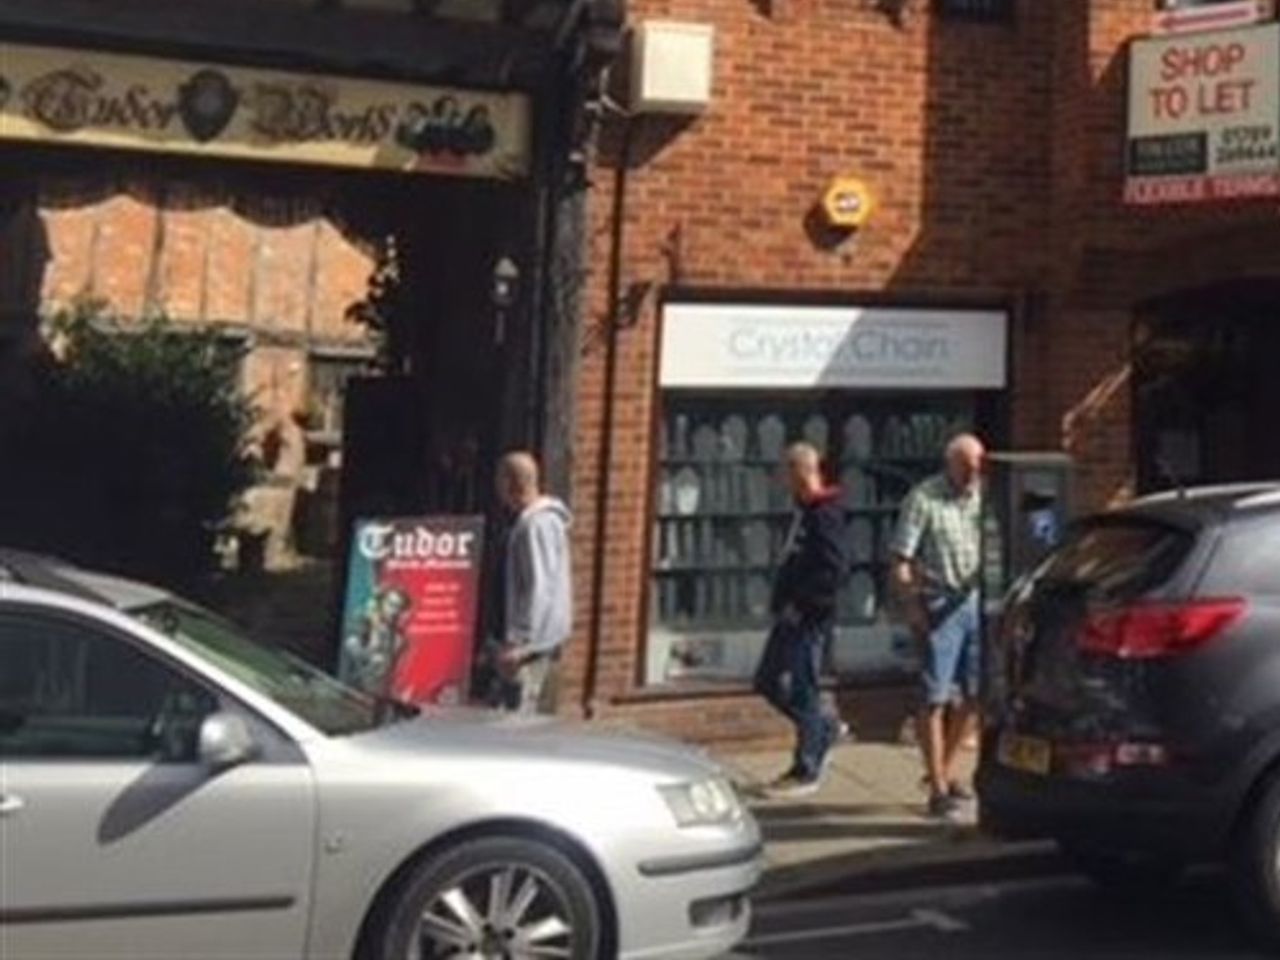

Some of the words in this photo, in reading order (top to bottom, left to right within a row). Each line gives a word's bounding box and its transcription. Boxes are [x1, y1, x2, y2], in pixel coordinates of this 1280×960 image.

[1160, 43, 1245, 82] SHOP
[1150, 87, 1188, 119] TO
[1199, 81, 1254, 115] LET
[358, 524, 475, 559] Tudor
